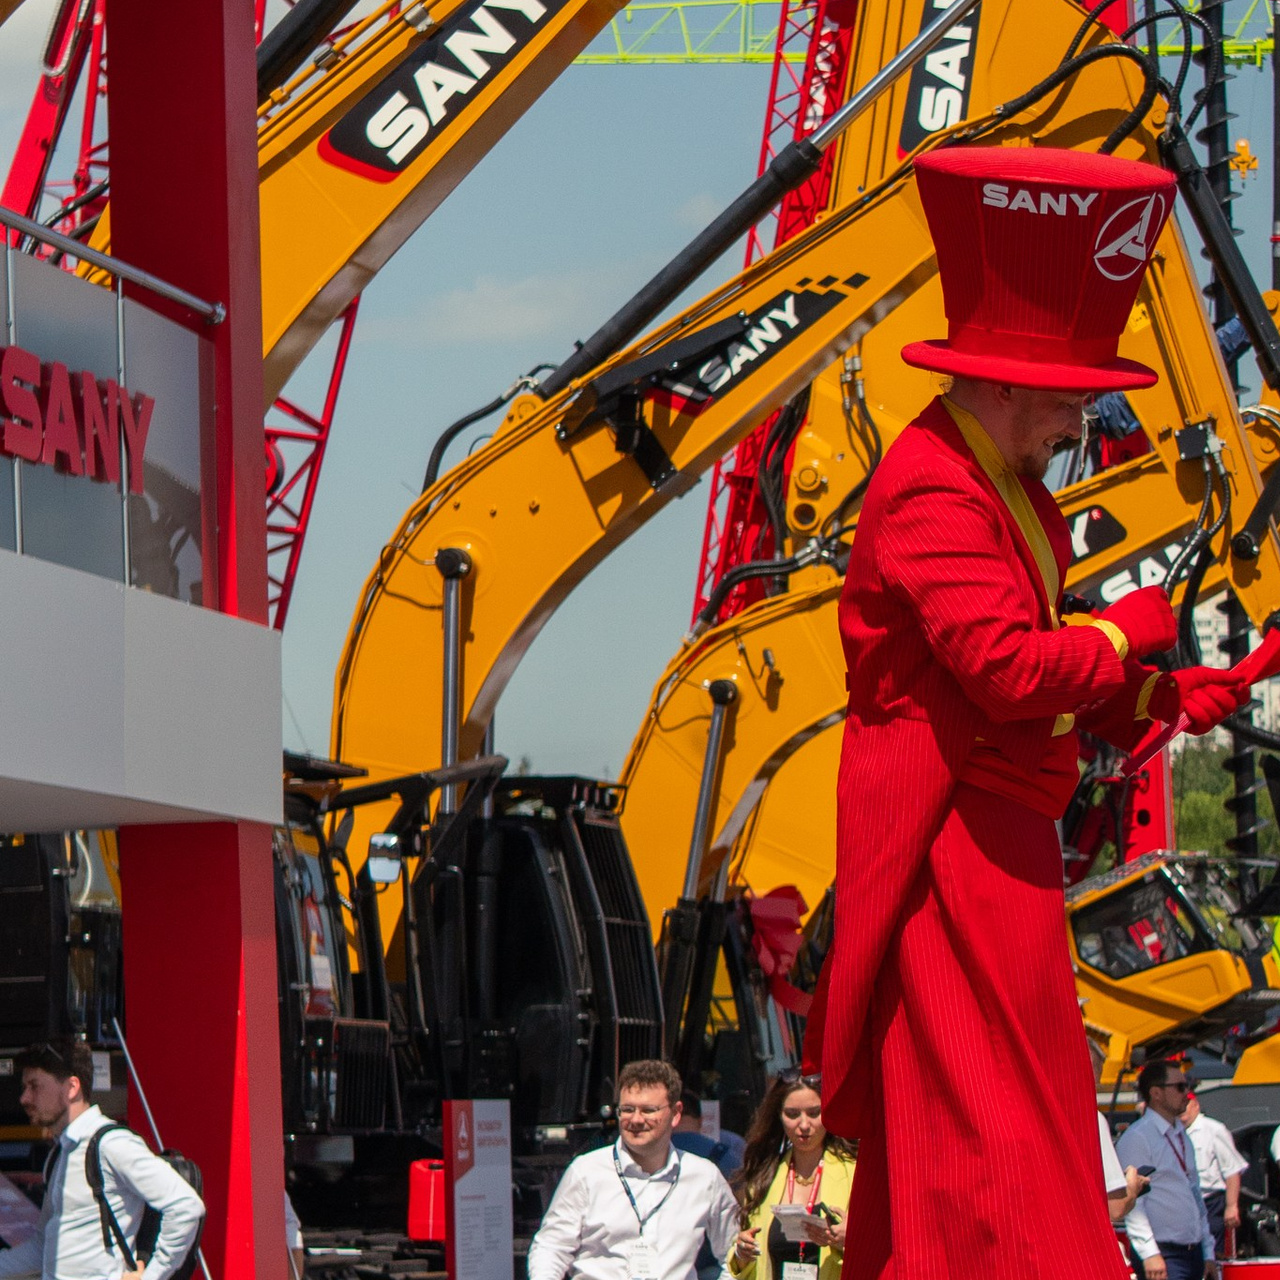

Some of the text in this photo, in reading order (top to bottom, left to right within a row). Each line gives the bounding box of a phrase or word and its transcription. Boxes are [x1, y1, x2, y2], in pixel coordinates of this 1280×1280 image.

[983, 183, 1099, 216] SANY
[699, 294, 800, 393] SANY
[1, 345, 155, 495] SANY
